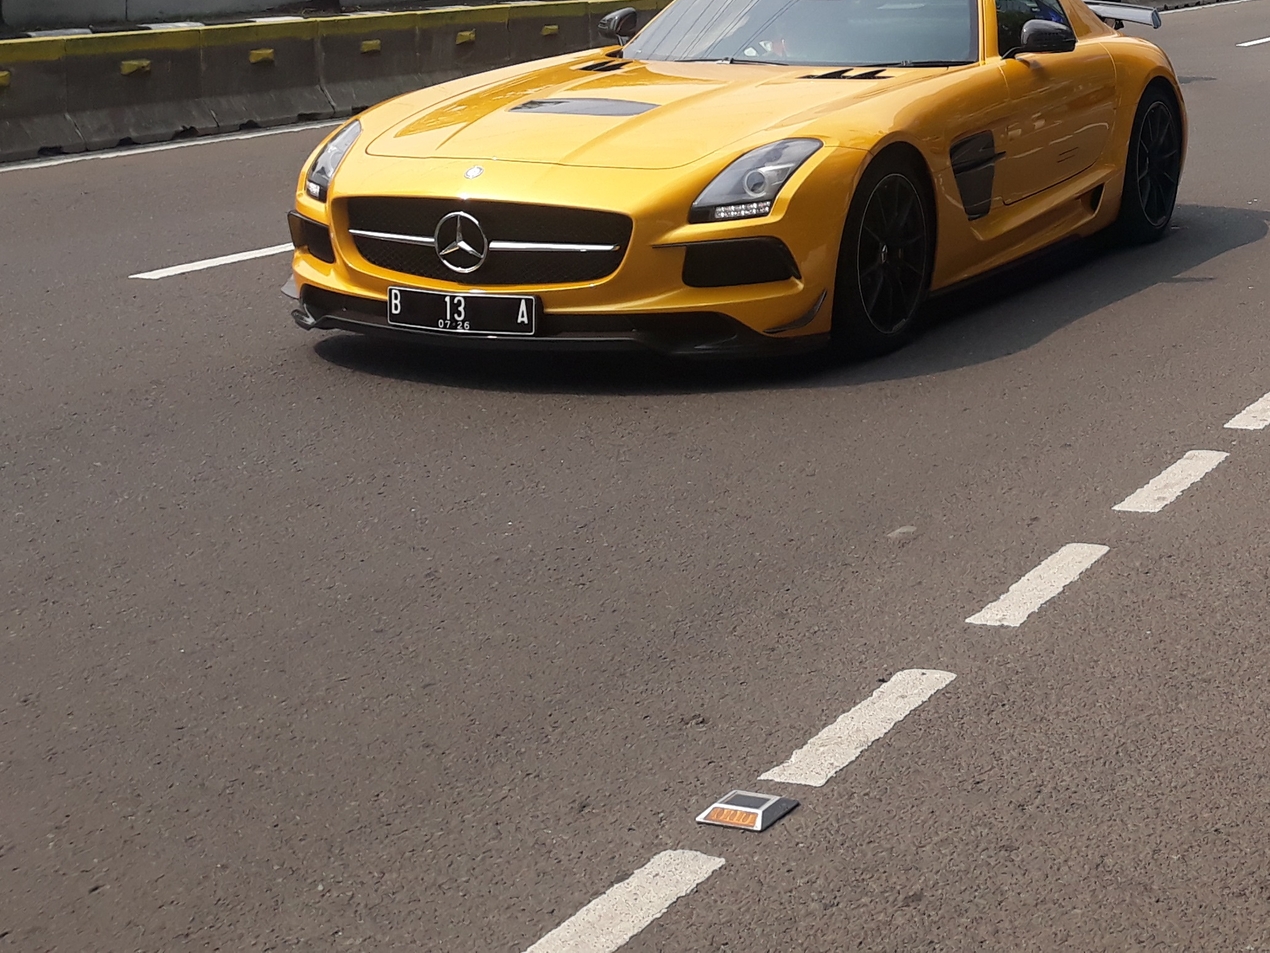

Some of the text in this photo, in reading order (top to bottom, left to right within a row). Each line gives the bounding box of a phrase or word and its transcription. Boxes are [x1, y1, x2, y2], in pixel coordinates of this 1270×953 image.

[391, 289, 529, 324] B 13 A
